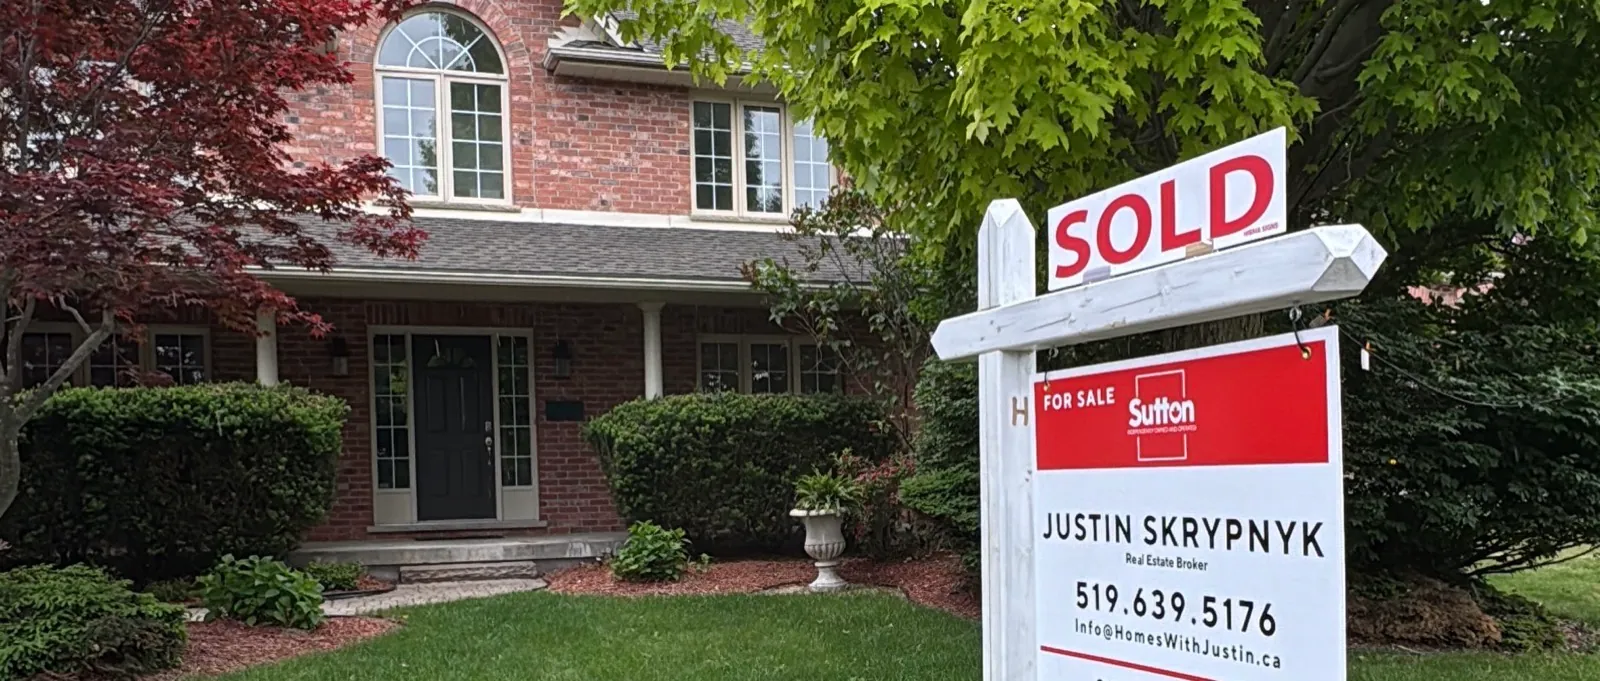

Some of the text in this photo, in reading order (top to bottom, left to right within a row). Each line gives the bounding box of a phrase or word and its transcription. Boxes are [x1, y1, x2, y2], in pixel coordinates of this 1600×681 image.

[1056, 155, 1274, 278] SOLD
[1012, 396, 1029, 426] H
[1043, 386, 1115, 411] FOR SALE
[1128, 397, 1195, 428] Sutton
[1042, 512, 1325, 558] JUSTIN SKRYPNYK
[1125, 553, 1208, 571] Real Estate Broker
[1075, 581, 1277, 637] 519.639.5176
[1075, 618, 1282, 670] Info@HomesWithJustin.ca
